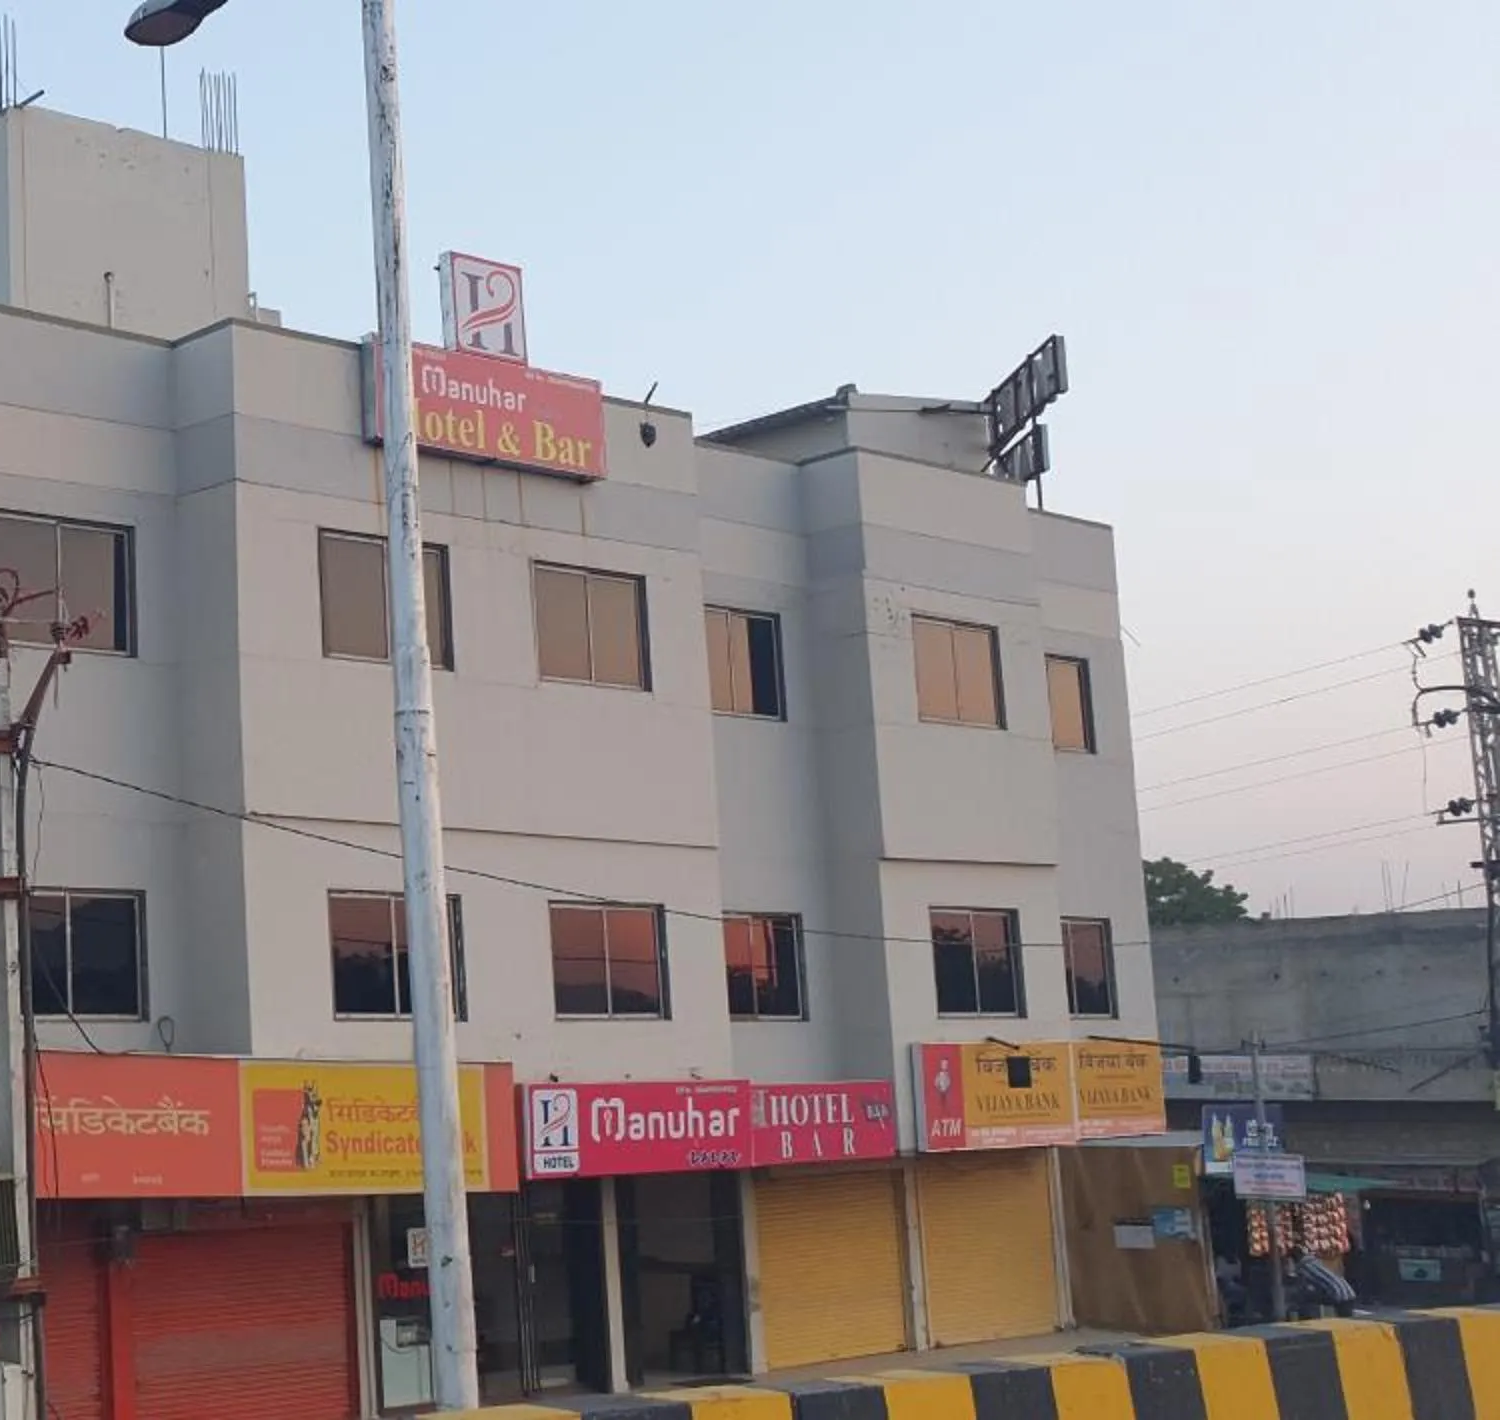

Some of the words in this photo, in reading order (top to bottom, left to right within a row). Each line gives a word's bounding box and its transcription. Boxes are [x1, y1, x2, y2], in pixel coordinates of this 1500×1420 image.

[422, 364, 527, 413] Manuhar
[497, 421, 521, 456] &
[532, 419, 592, 467] Bar
[590, 1096, 741, 1142] Manuhar
[769, 1092, 855, 1127] HOTEL
[931, 1119, 963, 1138] ATM
[543, 1158, 575, 1169] HOTEL
